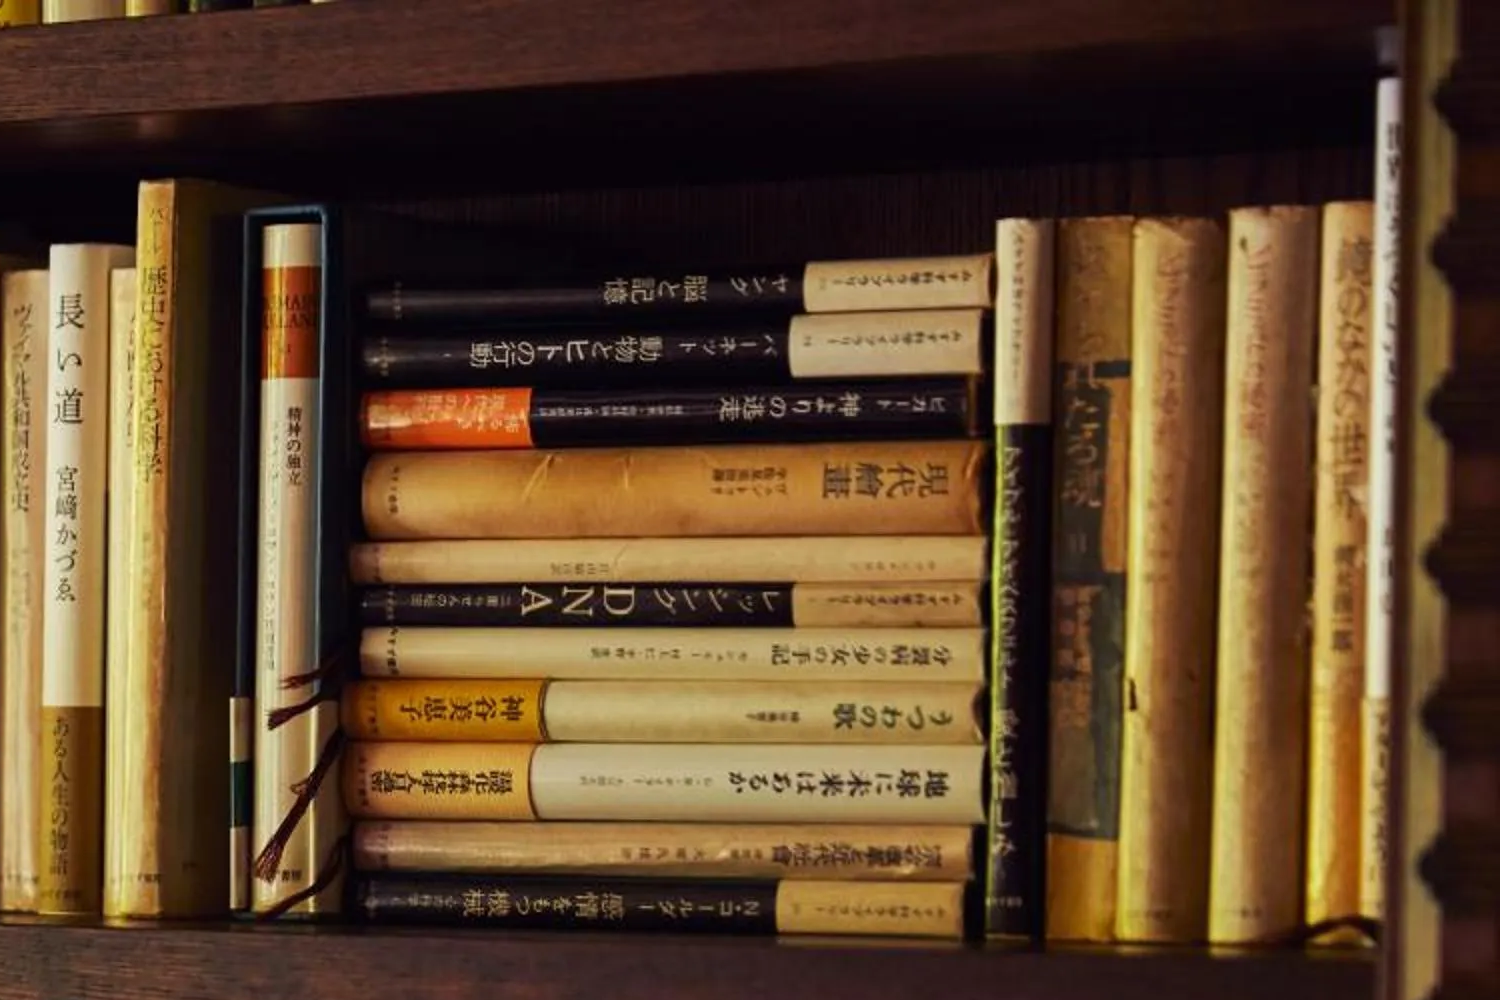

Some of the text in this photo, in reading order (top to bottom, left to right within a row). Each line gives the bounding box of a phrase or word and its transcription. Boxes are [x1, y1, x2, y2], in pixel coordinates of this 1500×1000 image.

[602, 272, 788, 305] ヤング 脳と記憶
[53, 293, 85, 425] 長い道
[469, 333, 778, 368] バーネット 動物とヒトの行動
[718, 392, 860, 423] 神よりの逃走
[652, 586, 781, 614] レッシング
[771, 644, 952, 667] 分裂病の少女の手記
[399, 695, 525, 723] 神谷美恵子
[833, 703, 953, 731] うつわの歌
[50, 718, 70, 876] ある人生の物語
[727, 768, 951, 800] 地球に未来はあるか
[461, 890, 624, 921] 感情をもつ機械
